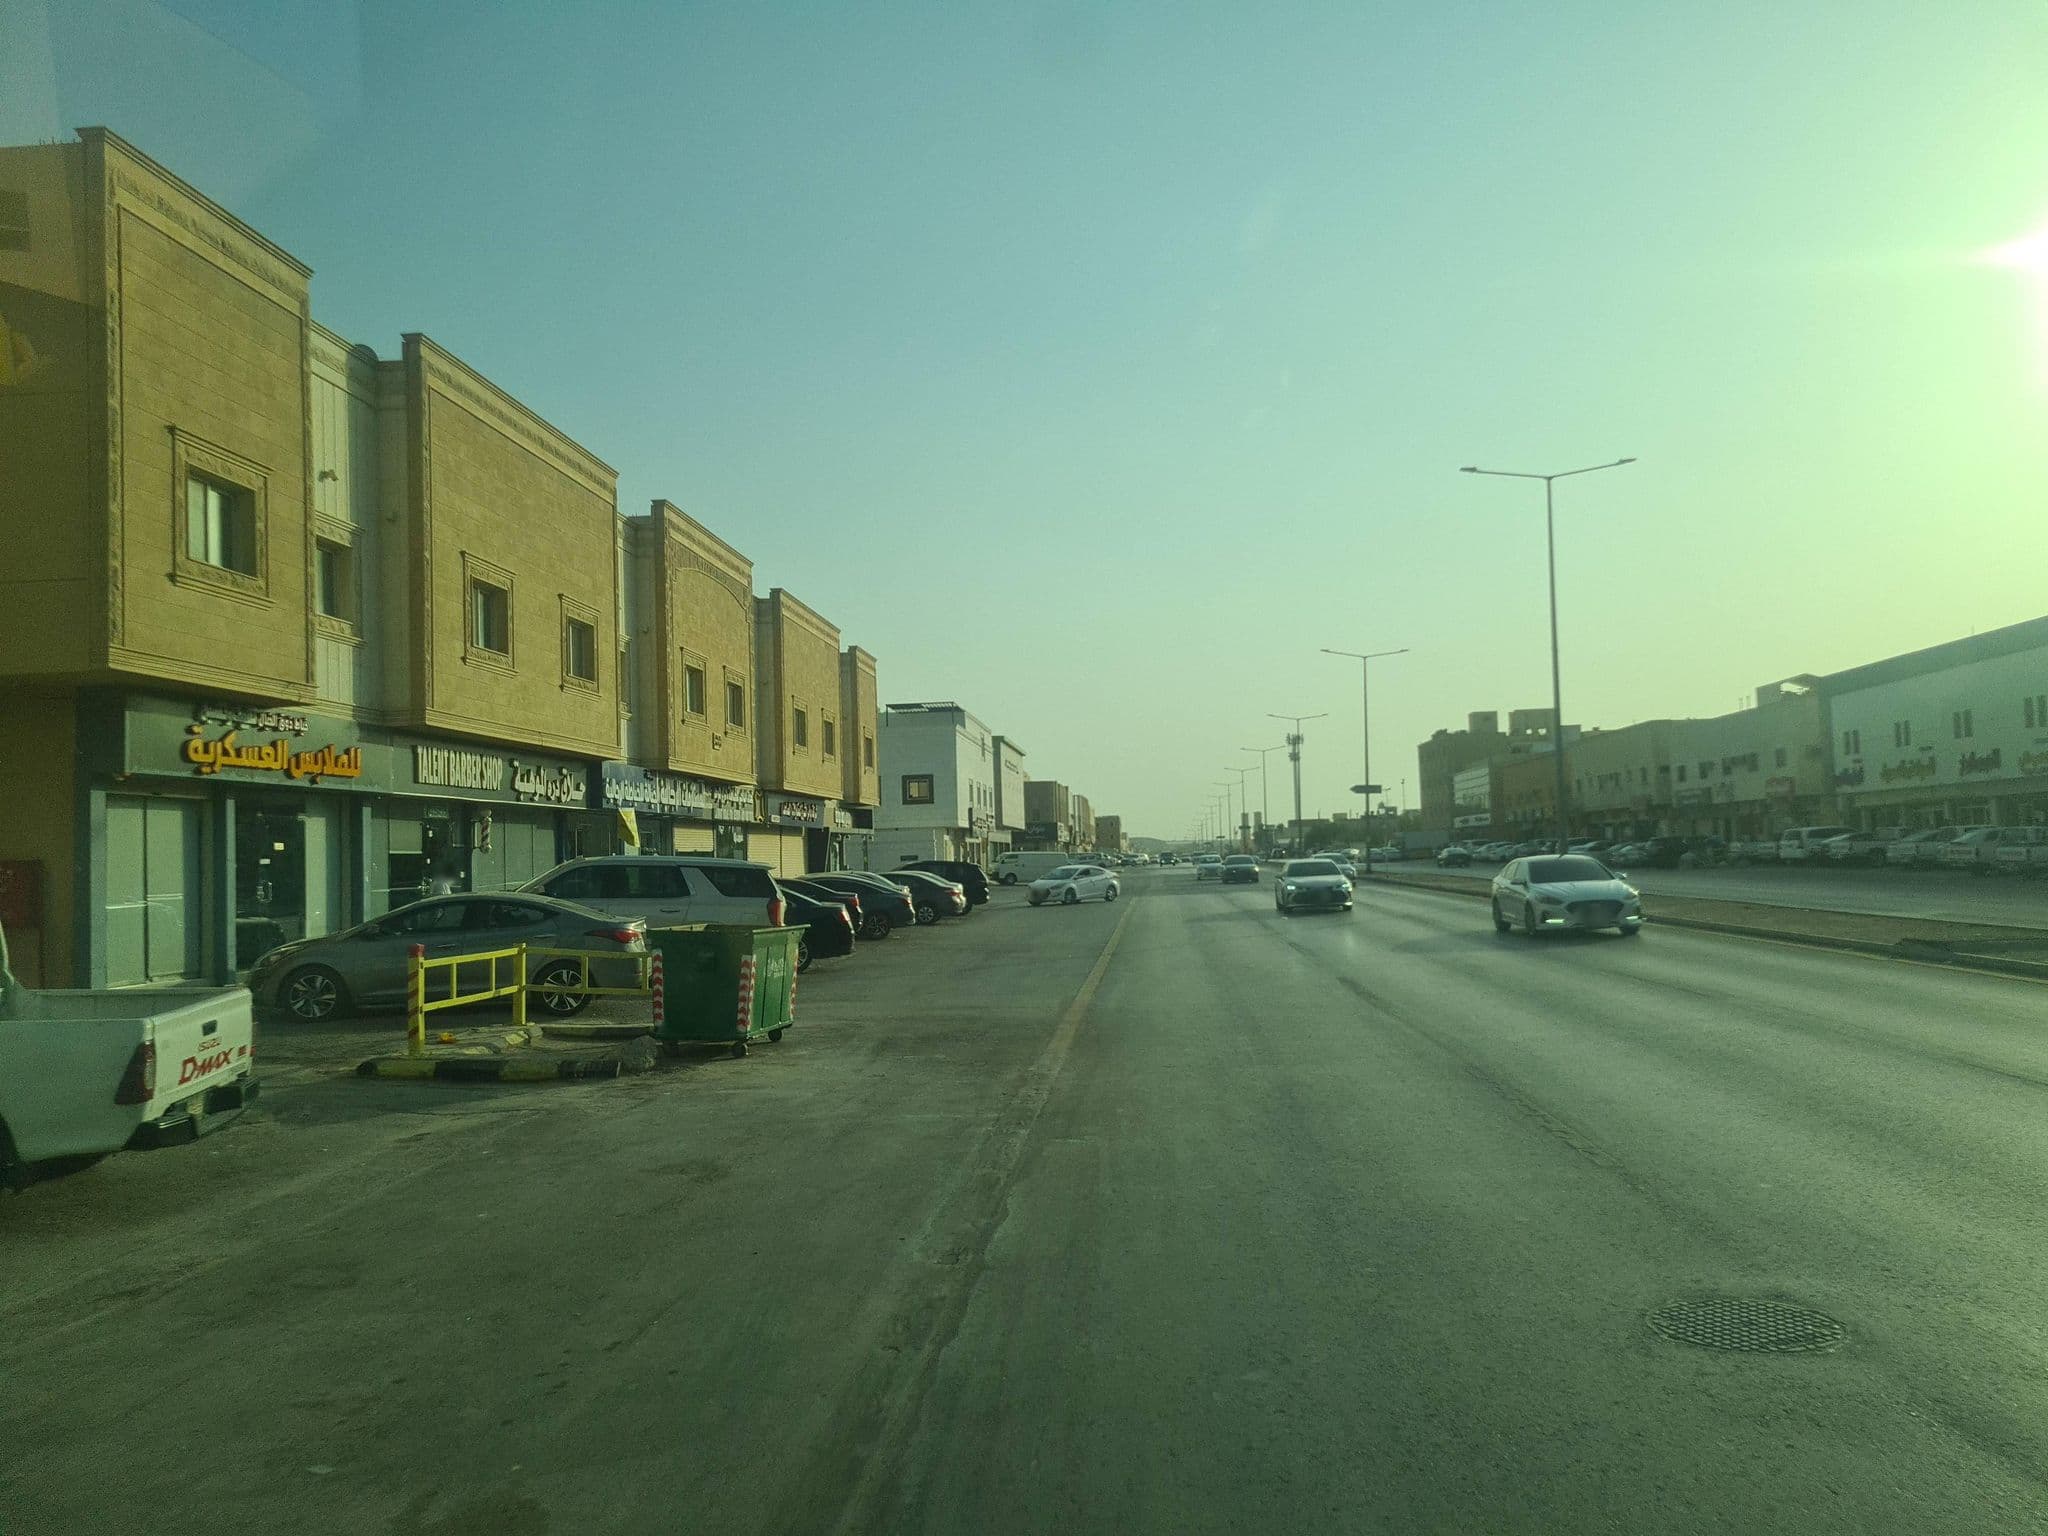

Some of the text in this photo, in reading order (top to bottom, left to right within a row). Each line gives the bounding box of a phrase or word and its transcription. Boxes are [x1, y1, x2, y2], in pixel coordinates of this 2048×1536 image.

[186, 724, 362, 785] للملابس العسكرية
[417, 745, 503, 791] TALENT BARBER SHOP
